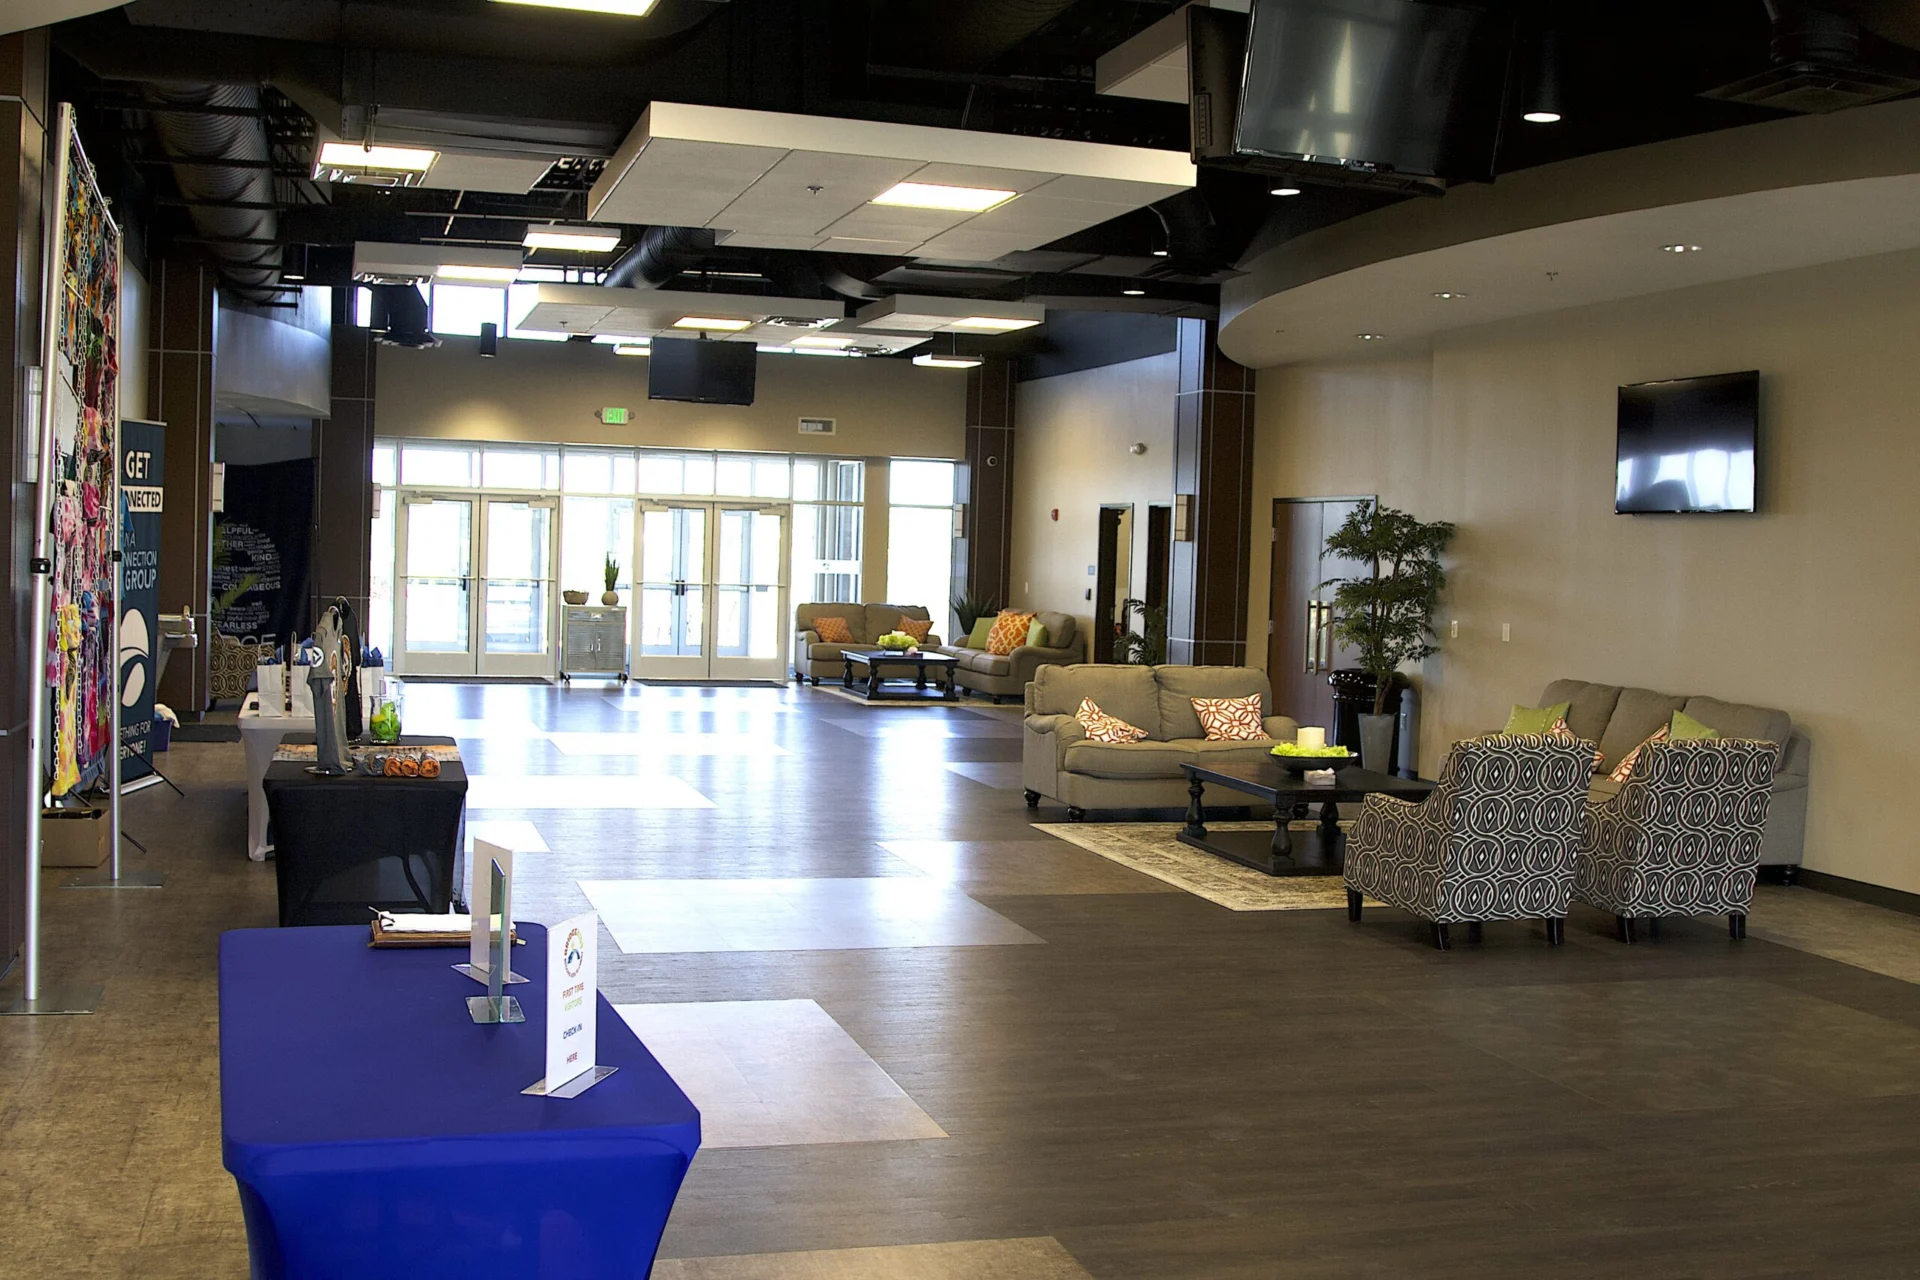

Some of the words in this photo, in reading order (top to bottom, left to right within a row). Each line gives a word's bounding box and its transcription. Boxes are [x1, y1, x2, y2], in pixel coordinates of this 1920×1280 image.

[605, 408, 625, 424] EXIT
[125, 450, 151, 479] GET
[124, 490, 161, 507] NNECTED
[251, 553, 272, 561] KIND
[125, 568, 157, 591] GROUP
[221, 581, 280, 591] COUAGEOUS
[214, 621, 257, 629] EARLESS
[120, 723, 139, 739] ETHING
[139, 720, 151, 734] FOR
[562, 986, 573, 999] FIRST
[574, 981, 584, 994] TIME
[564, 996, 582, 1011] VISITORS
[566, 1051, 577, 1064] HERE
